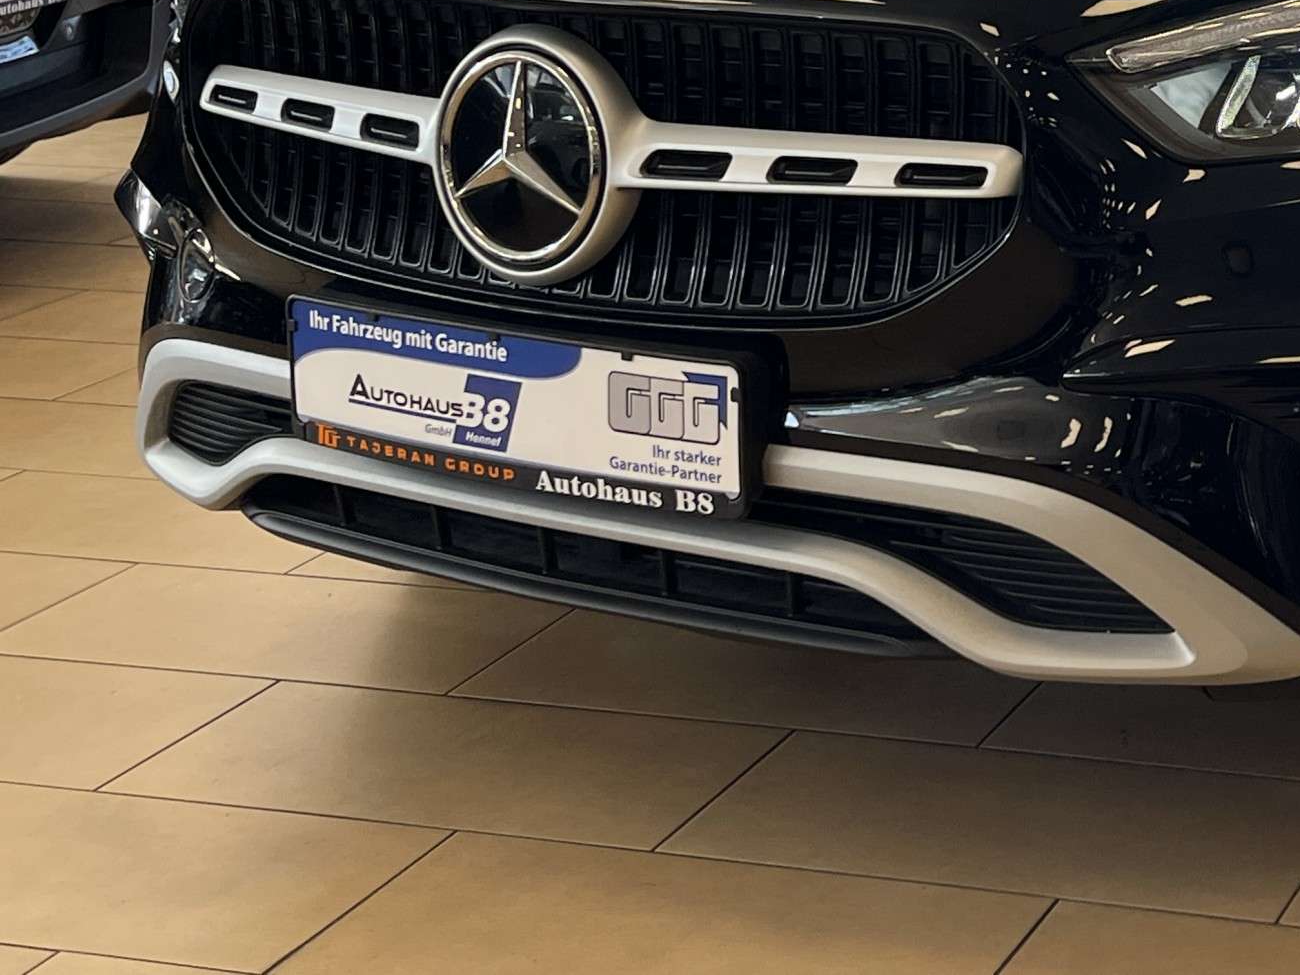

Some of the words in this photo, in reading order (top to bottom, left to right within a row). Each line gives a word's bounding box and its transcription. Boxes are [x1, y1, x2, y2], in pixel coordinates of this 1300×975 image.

[309, 310, 330, 331] Ihr
[332, 314, 402, 349] Fahrzeug
[405, 329, 432, 350] mit
[435, 333, 508, 362] Garantie
[350, 373, 464, 418] AUTOHAUS
[457, 391, 511, 433] B8
[346, 435, 435, 466] TAJERAN
[444, 458, 515, 481] GROUP
[425, 424, 452, 436] GmbH
[465, 431, 502, 447] Hennef
[652, 445, 671, 459] Ihr
[673, 449, 722, 466] starker
[535, 470, 663, 508] Autohaus
[675, 489, 715, 515] B8
[609, 456, 722, 484] Garantie-Partner
